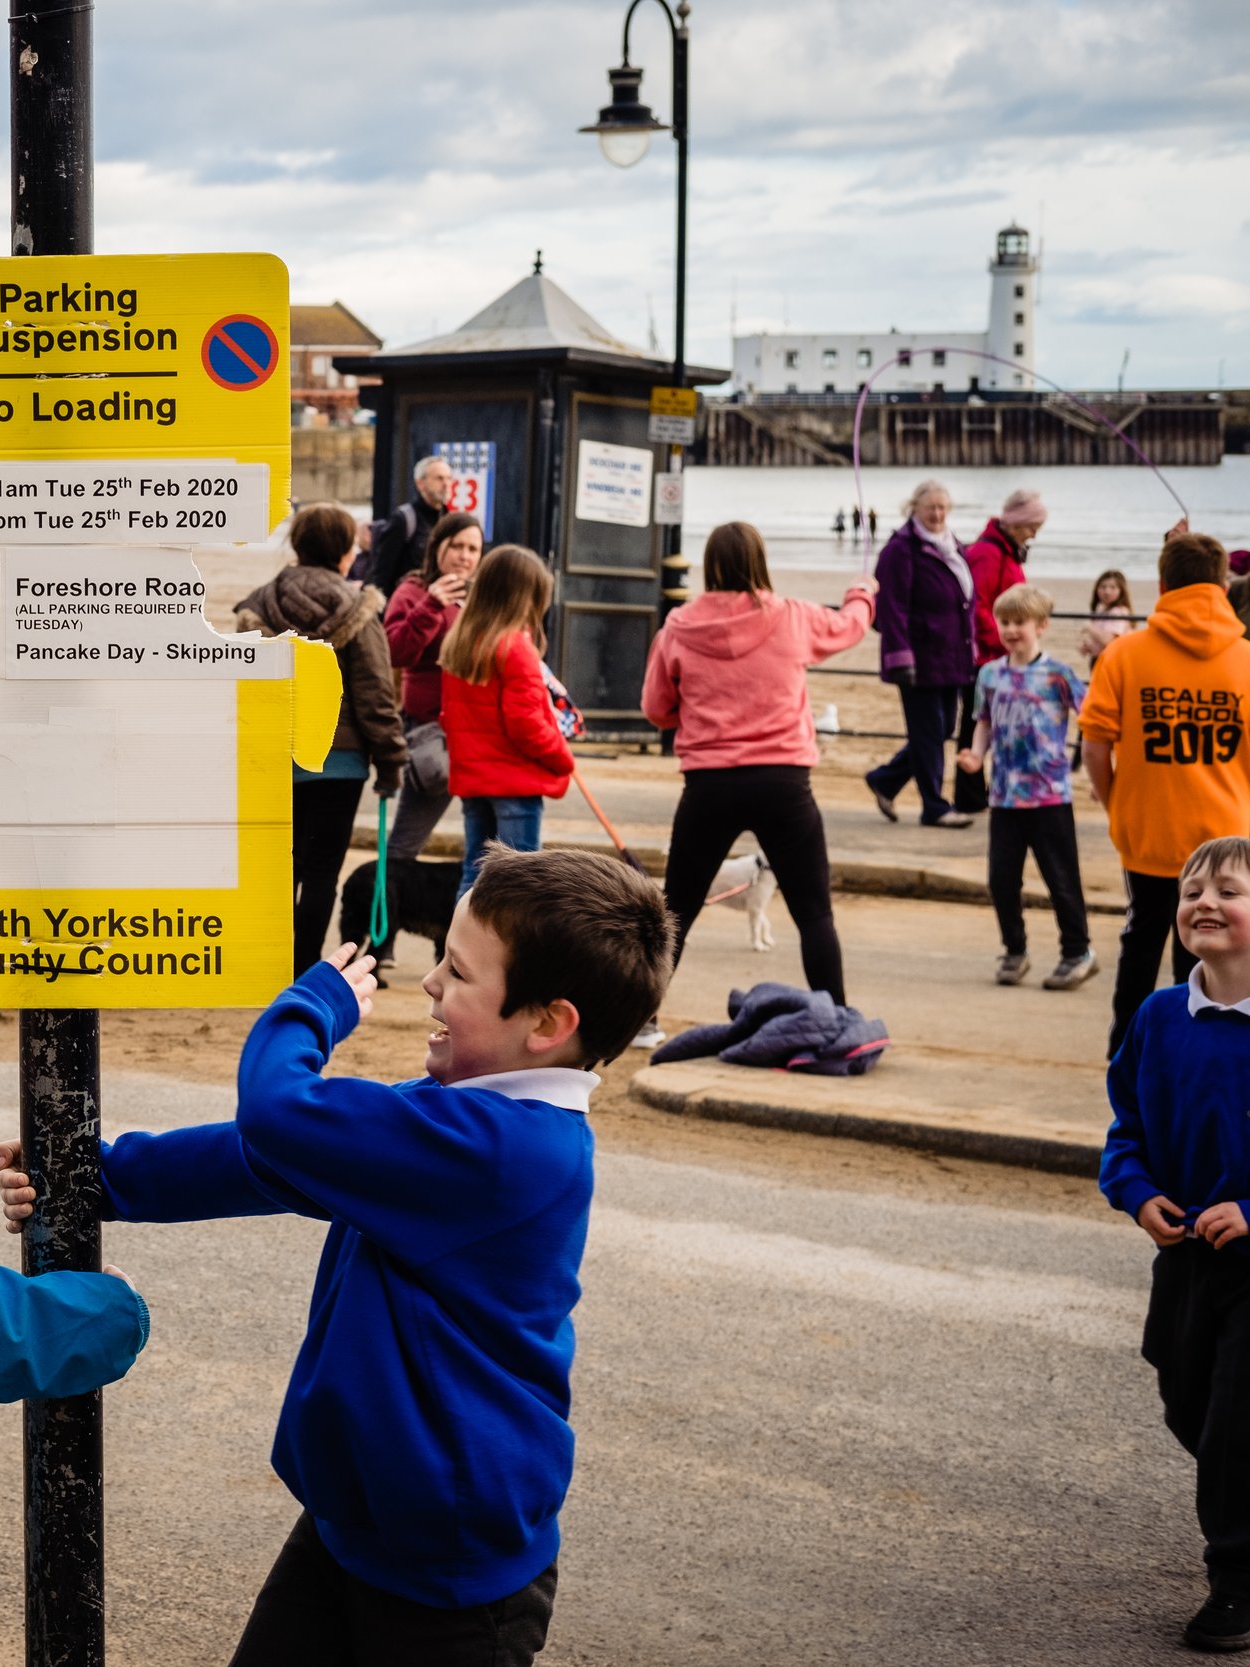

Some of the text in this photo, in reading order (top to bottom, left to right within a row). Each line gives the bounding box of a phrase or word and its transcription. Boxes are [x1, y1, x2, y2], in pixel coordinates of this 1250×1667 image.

[0, 282, 137, 318] Parking
[32, 390, 176, 426] Loading
[44, 479, 86, 498] Tue
[92, 476, 132, 497] 25th
[140, 478, 180, 497] Feb
[187, 478, 238, 497] 2020
[33, 511, 74, 529] Tue
[81, 508, 121, 529] 25th
[128, 510, 169, 529] Feb
[175, 510, 227, 529] 2020
[16, 577, 137, 597] Foreshore
[15, 603, 45, 617] (ALL
[49, 603, 111, 615] PARKING
[114, 603, 186, 615] REQUIRED
[15, 619, 83, 632] TUESDAY)
[16, 643, 101, 660] Pancake
[107, 643, 146, 664] Day
[166, 643, 256, 664] Skipping
[1139, 686, 1245, 709] SCALBY
[1140, 703, 1244, 725] SCHOOL
[1142, 720, 1243, 766] 2019
[42, 908, 223, 938] Yorkshire
[77, 943, 223, 976] Council
